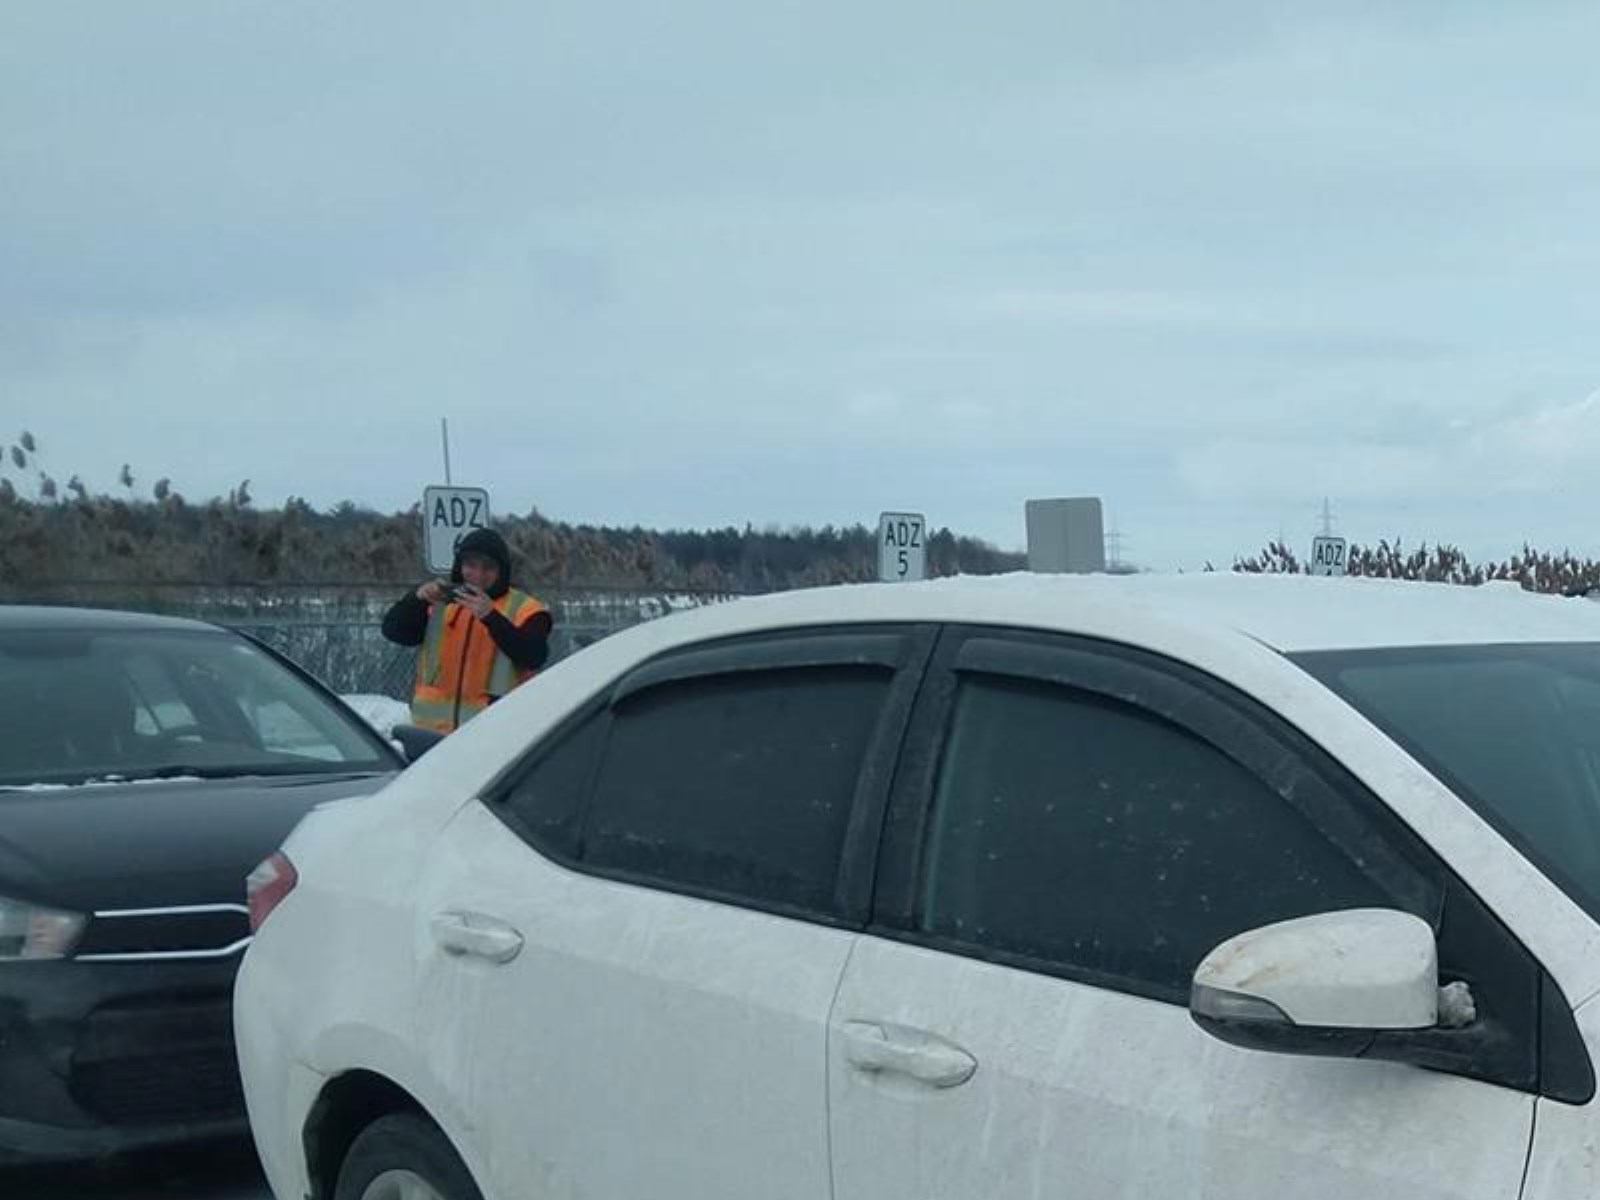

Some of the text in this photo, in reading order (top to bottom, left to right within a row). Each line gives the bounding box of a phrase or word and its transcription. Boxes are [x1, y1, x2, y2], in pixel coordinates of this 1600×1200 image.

[432, 495, 483, 528] ADZ
[884, 520, 921, 547] ADZ
[897, 550, 909, 576] 5
[1315, 543, 1342, 566] ADZ
